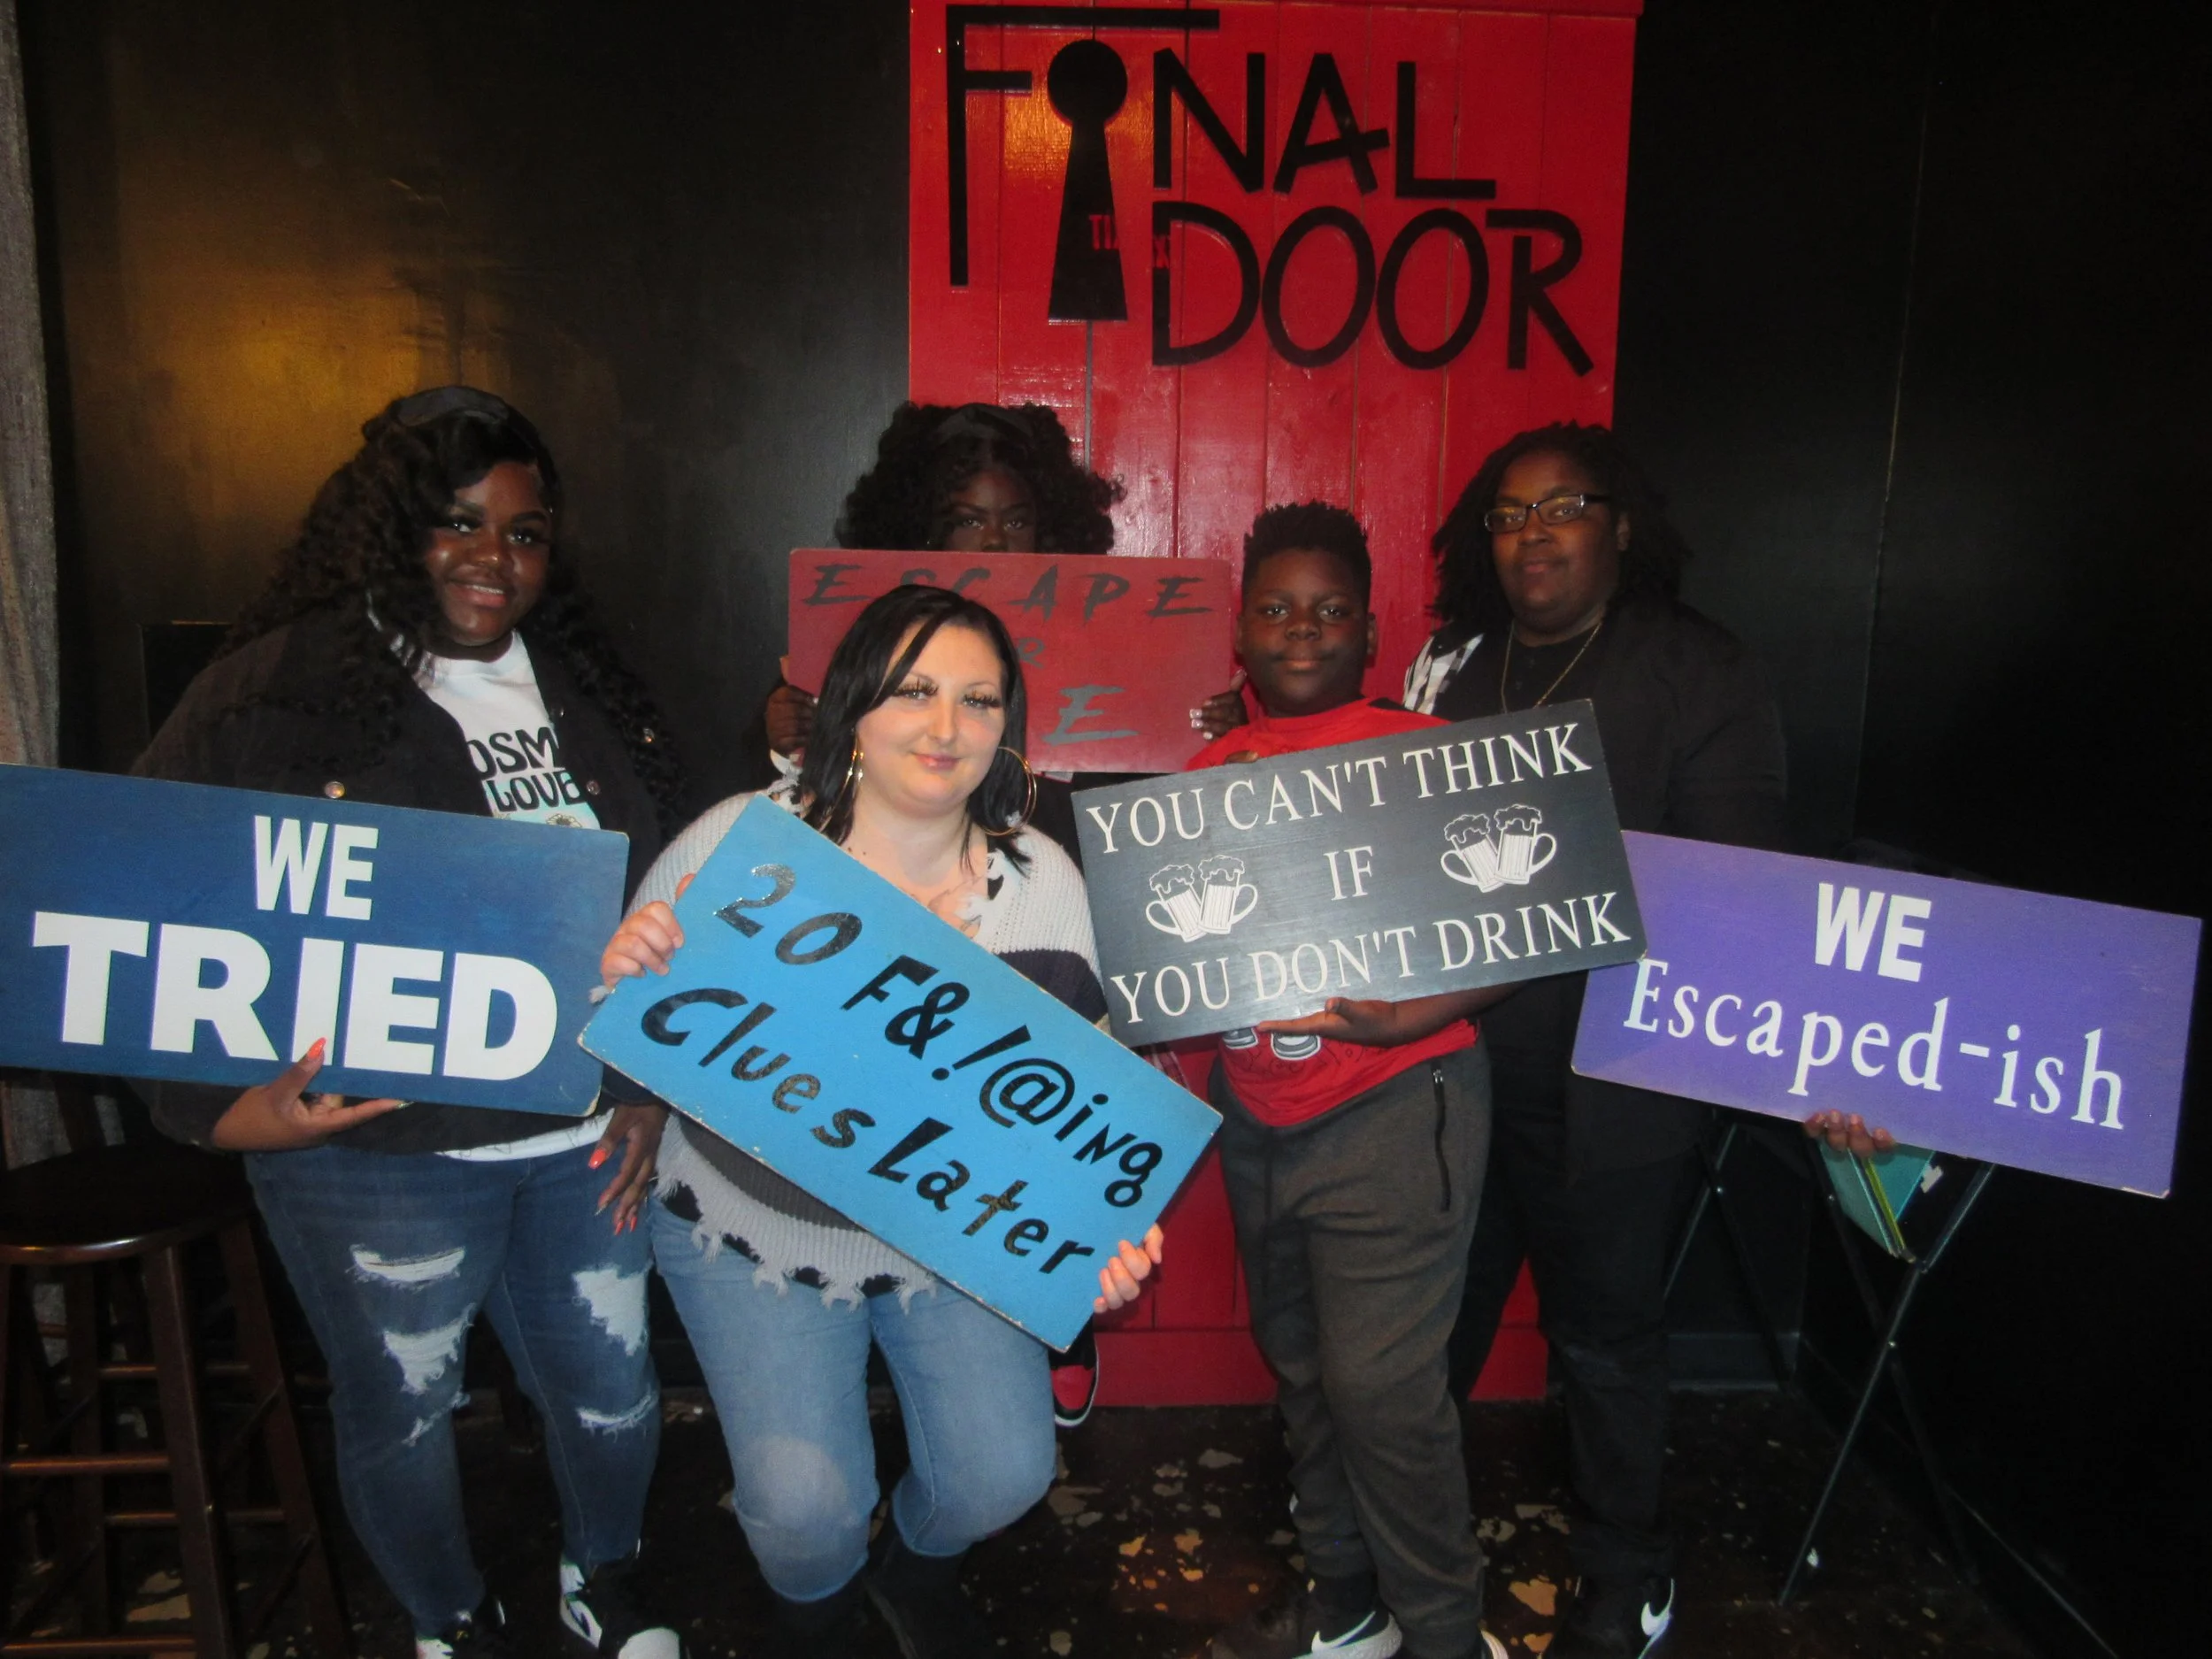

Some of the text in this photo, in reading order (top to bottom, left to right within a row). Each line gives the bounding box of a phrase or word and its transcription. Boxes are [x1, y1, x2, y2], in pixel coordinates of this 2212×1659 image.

[1152, 201, 1594, 375] DOOR
[1087, 722, 1593, 855] YOU CAN'T THINK
[254, 815, 379, 920] WE
[713, 864, 863, 965] 20
[1324, 846, 1374, 902] IF
[1814, 882, 1932, 982] WE
[33, 910, 557, 1081] TRIED
[1111, 891, 1632, 1025] YOU DON'T DRINK
[1624, 957, 2124, 1130] Escaped-ish
[641, 987, 1094, 1275] Clues Later
